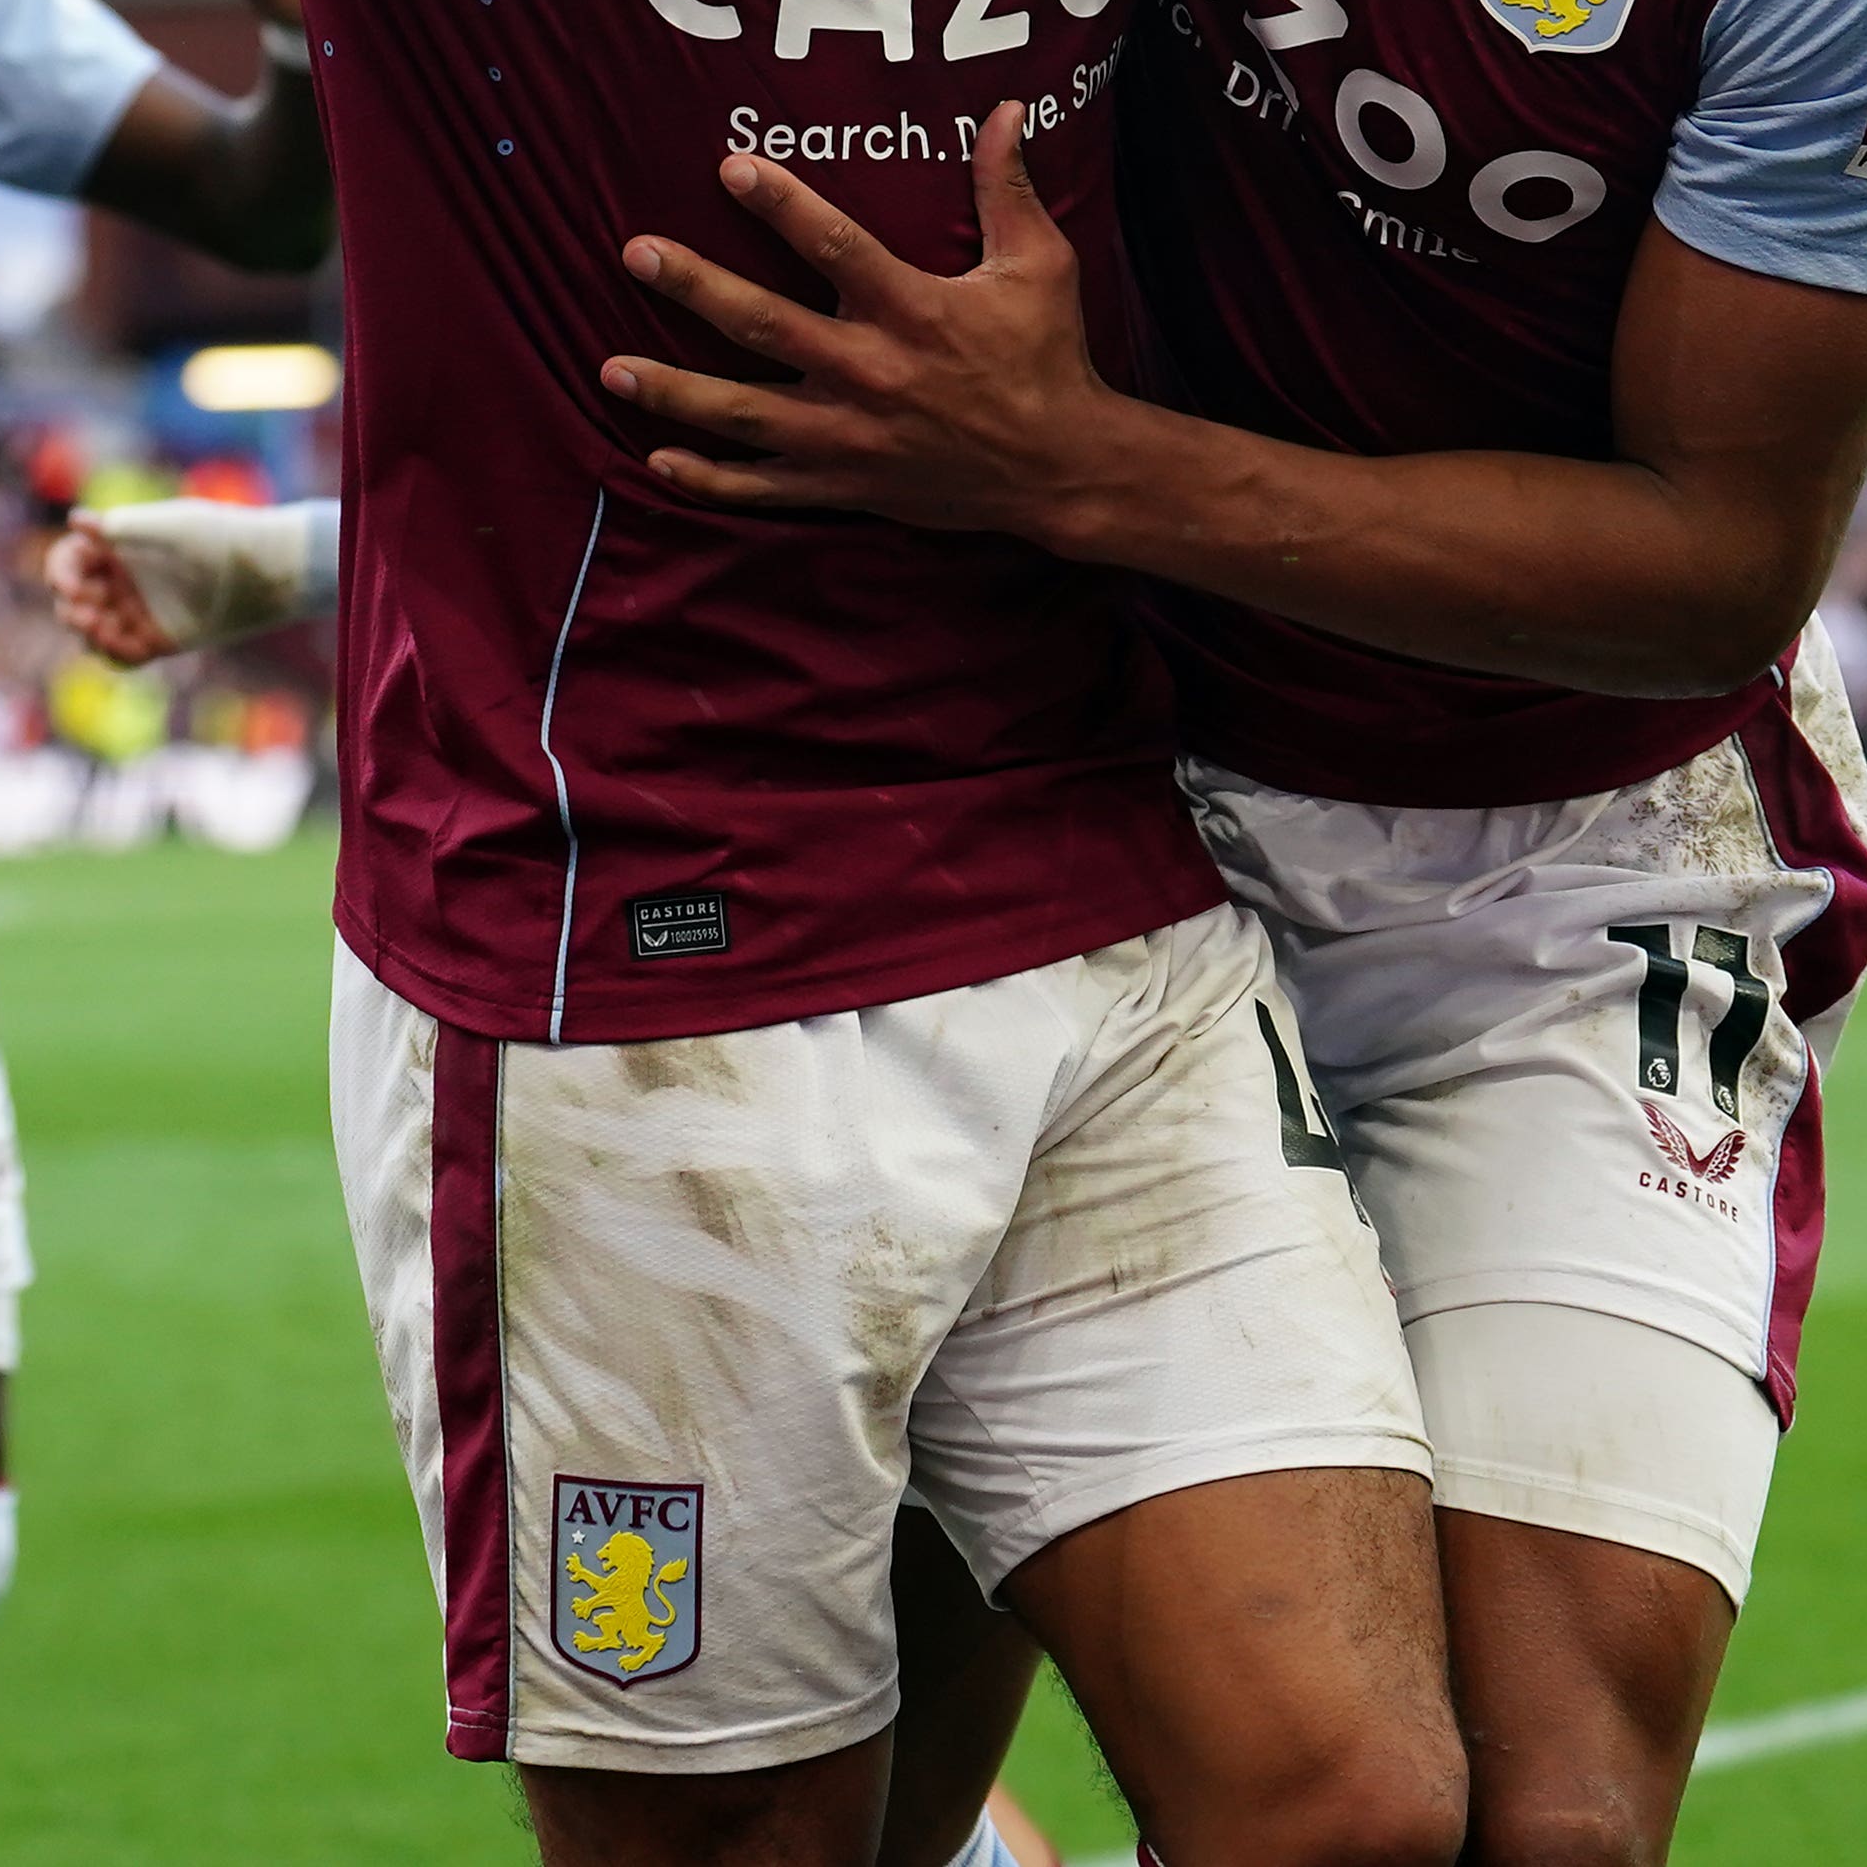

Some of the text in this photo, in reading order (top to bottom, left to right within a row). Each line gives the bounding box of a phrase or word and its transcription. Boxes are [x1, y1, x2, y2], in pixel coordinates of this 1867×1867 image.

[726, 105, 947, 161] Search.
[955, 93, 1066, 162] Dve.
[640, 901, 717, 921] CASTORE
[1606, 923, 1770, 1125] 11
[1638, 1171, 1739, 1223] CASTORE
[564, 1489, 691, 1532] AVFC
